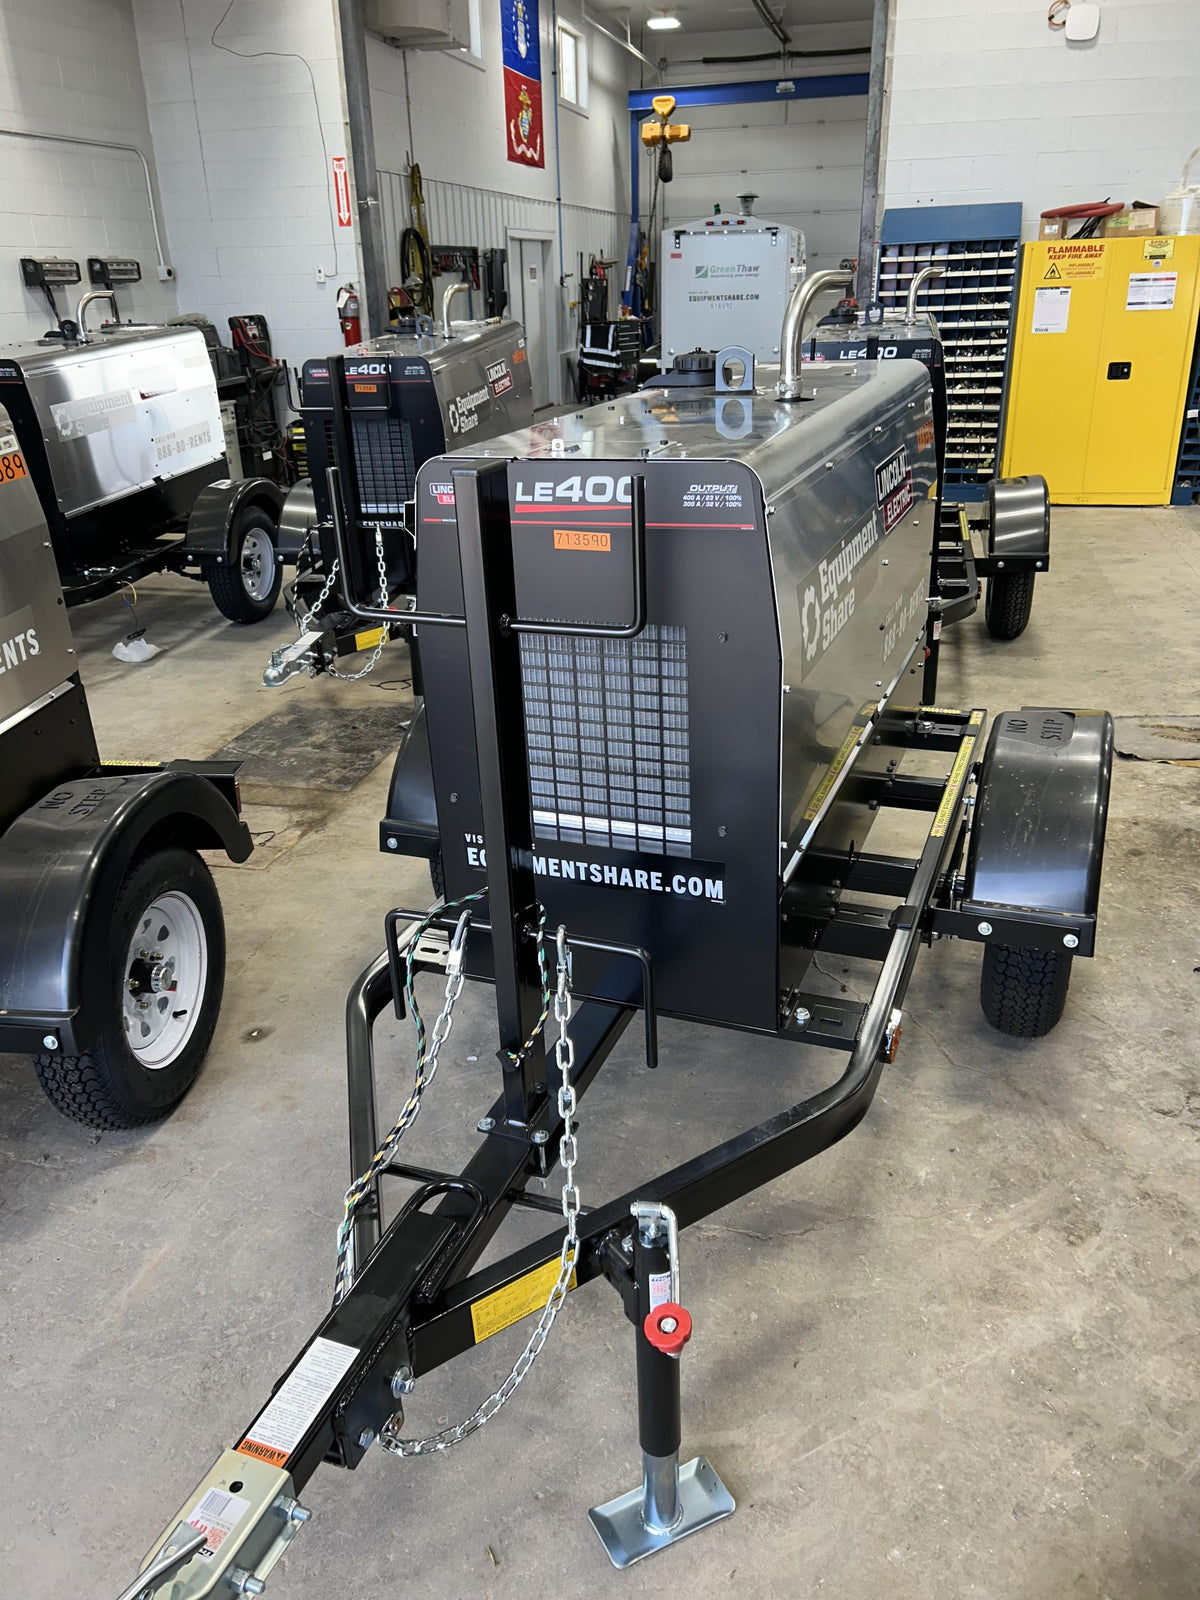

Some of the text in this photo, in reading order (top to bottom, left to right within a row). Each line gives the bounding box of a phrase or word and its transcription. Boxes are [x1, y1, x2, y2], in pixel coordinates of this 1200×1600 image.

[1048, 244, 1104, 254] FLAMMABLE
[689, 294, 760, 302] EQUIPMENTSHARE.COM
[456, 385, 490, 414] Equipment
[460, 414, 478, 433] Share
[157, 430, 212, 460] 888-80-RENTS
[0, 454, 26, 482] 89
[877, 452, 908, 501] LINCOLN
[433, 485, 454, 494] LINC
[515, 476, 647, 503] LE400
[886, 483, 912, 525] ELECTRIC
[556, 532, 608, 546] 713590
[818, 510, 878, 604] Equipment
[822, 587, 855, 651] Share
[1006, 719, 1028, 734] NO
[38, 788, 110, 815] NO STEP
[464, 834, 484, 844] VIS
[467, 847, 724, 900] EMENTSHARE.COM
[240, 1440, 275, 1460] WARNING
